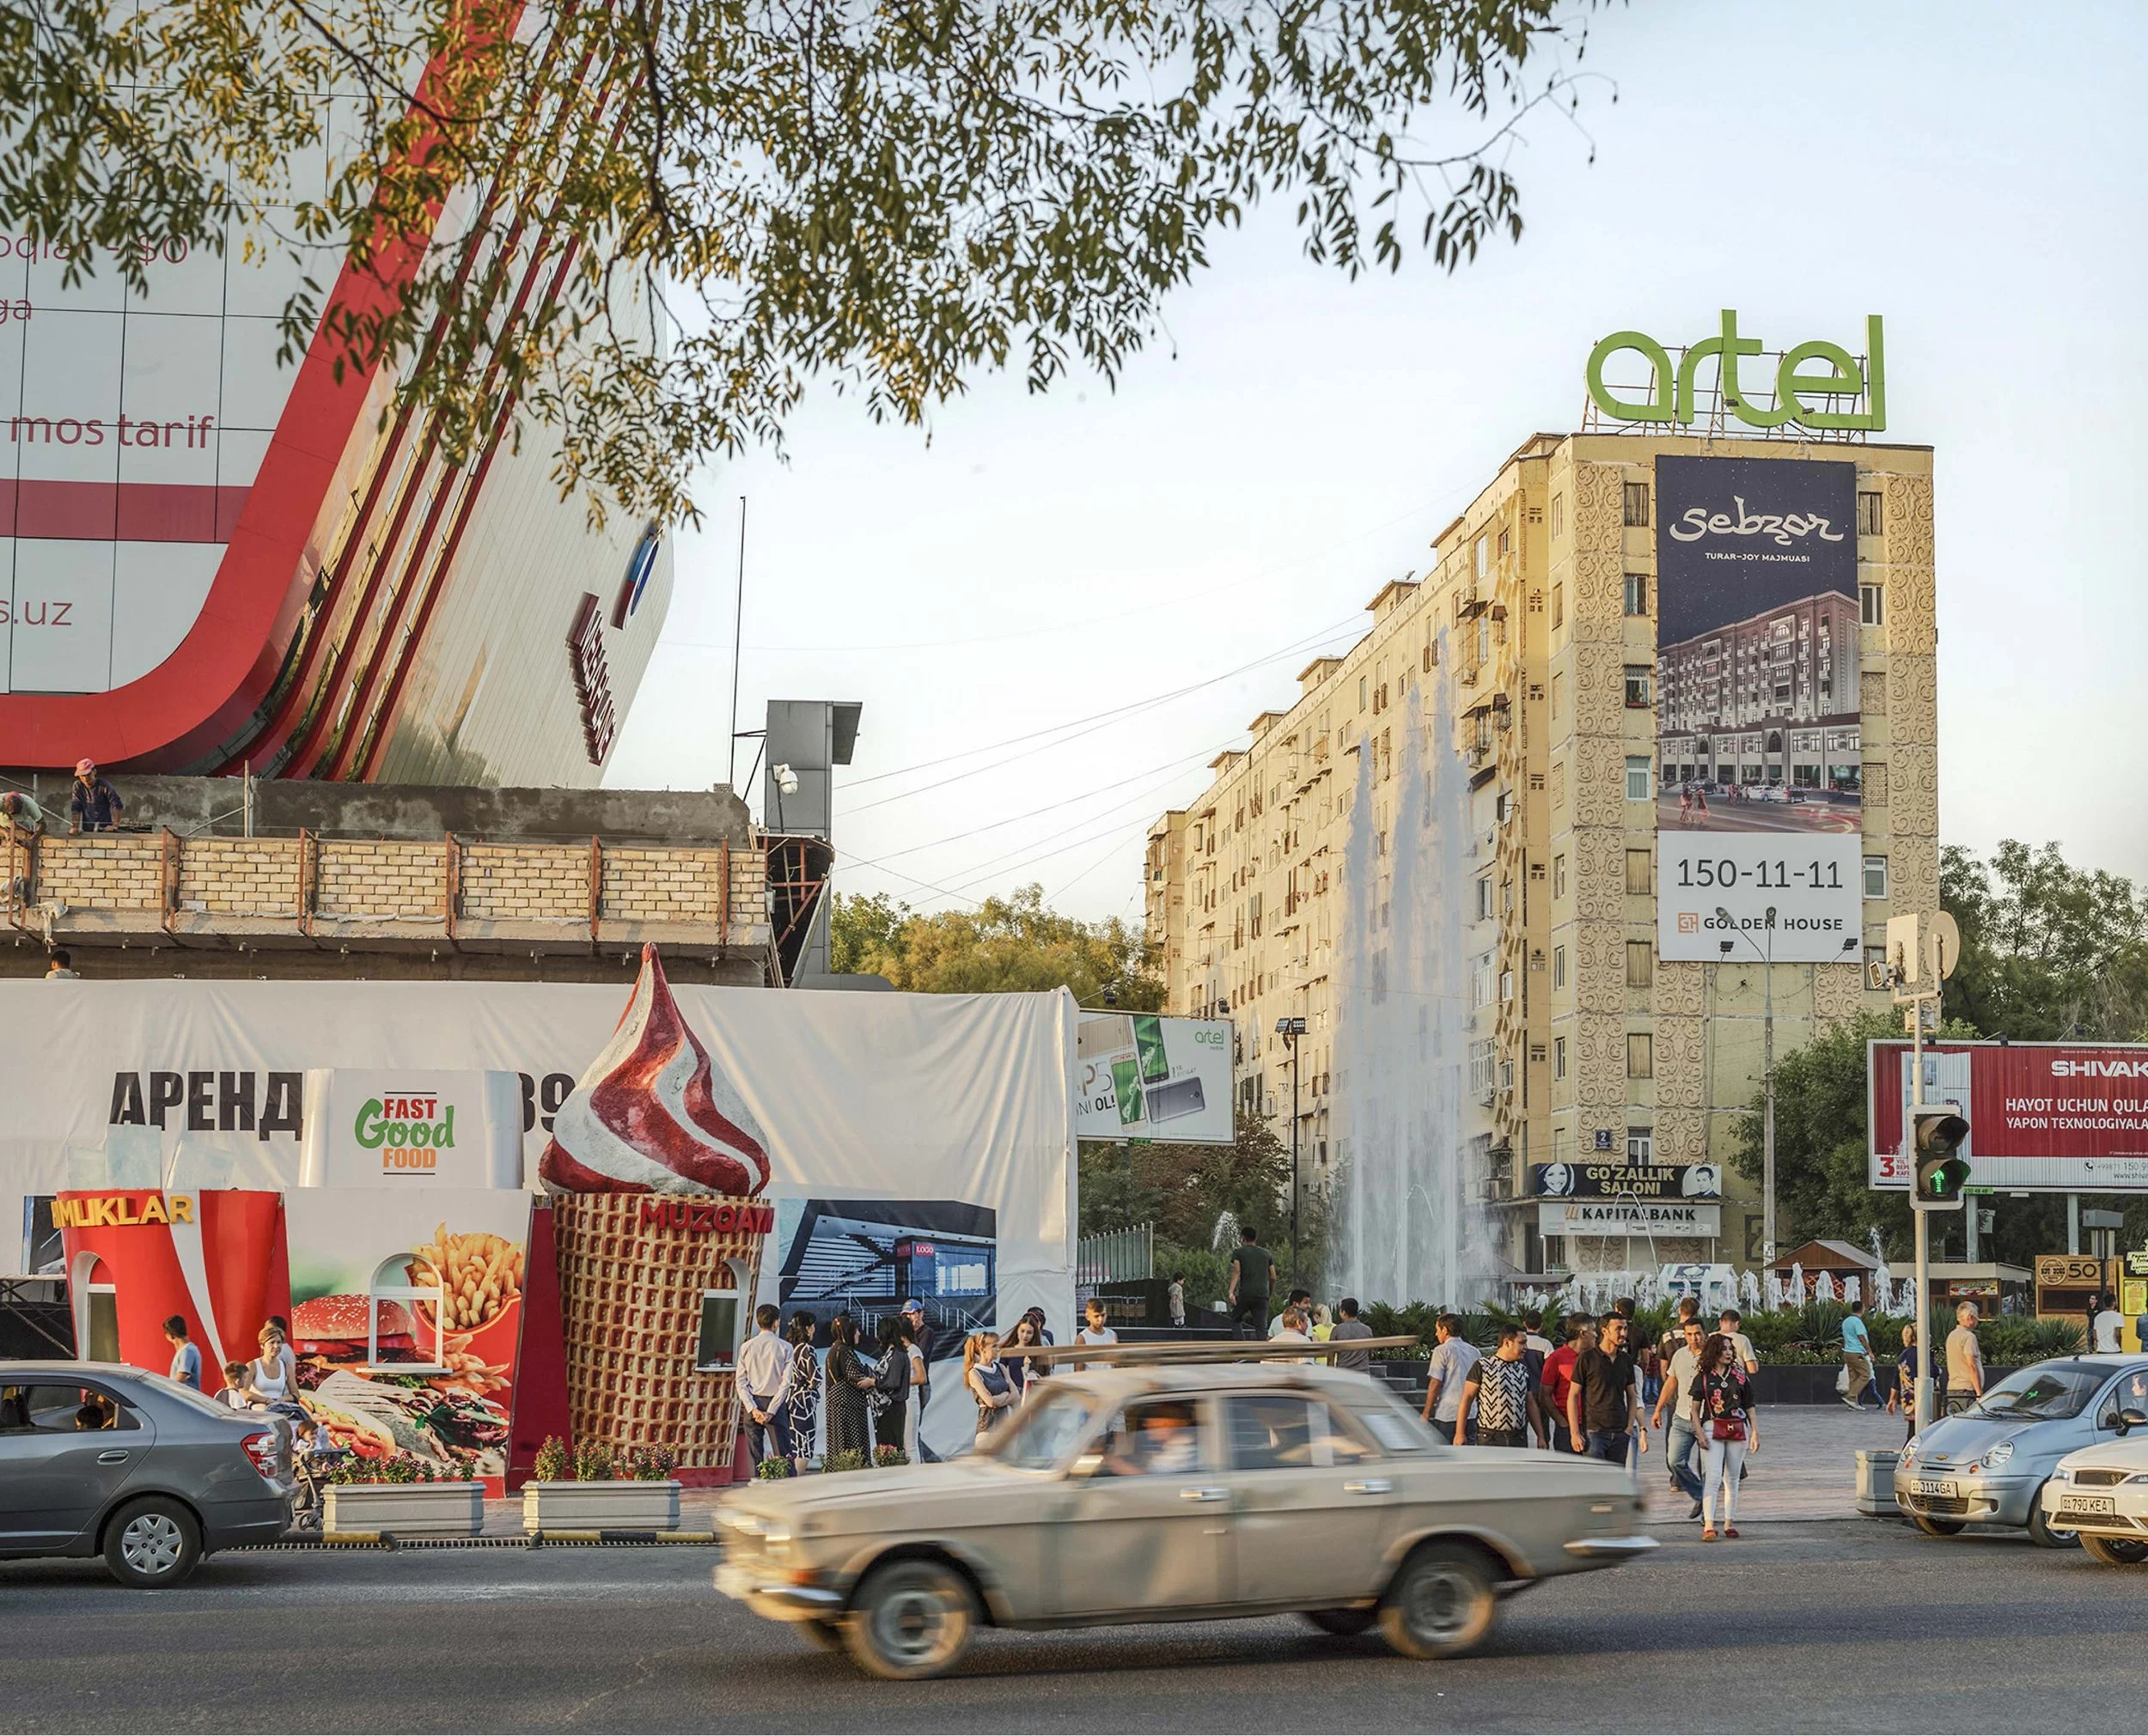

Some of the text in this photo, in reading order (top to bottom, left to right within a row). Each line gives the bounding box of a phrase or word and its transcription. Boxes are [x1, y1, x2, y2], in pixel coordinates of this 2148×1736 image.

[1584, 308, 1886, 432] artel
[10, 413, 215, 448] mos tarif
[1705, 552, 1810, 563] TURAR-JOY MAJMUASI
[0, 600, 73, 626] s.uz
[1677, 858, 1843, 889] 150-11-11
[1704, 917, 1776, 930] GOLDEN
[1784, 918, 1843, 930] HOUSE
[1195, 1028, 1224, 1045] artel
[383, 1099, 437, 1119] FAST
[1095, 1094, 1116, 1112] OL!
[2005, 1098, 2053, 1112] HAYOT
[2057, 1099, 2108, 1112] UCHUN
[354, 1098, 455, 1149] Good
[2006, 1117, 2048, 1129] YAPON
[1600, 1131, 1607, 1142] 2
[382, 1148, 436, 1168] FOOD
[1879, 1157, 1895, 1178] 3
[1600, 1181, 1662, 1195] SALONI
[1583, 1208, 1696, 1221] KAPITALBANK
[2068, 1264, 2102, 1278] 50
[2072, 1499, 2087, 1511] 790
[2090, 1500, 2108, 1512] KEA
